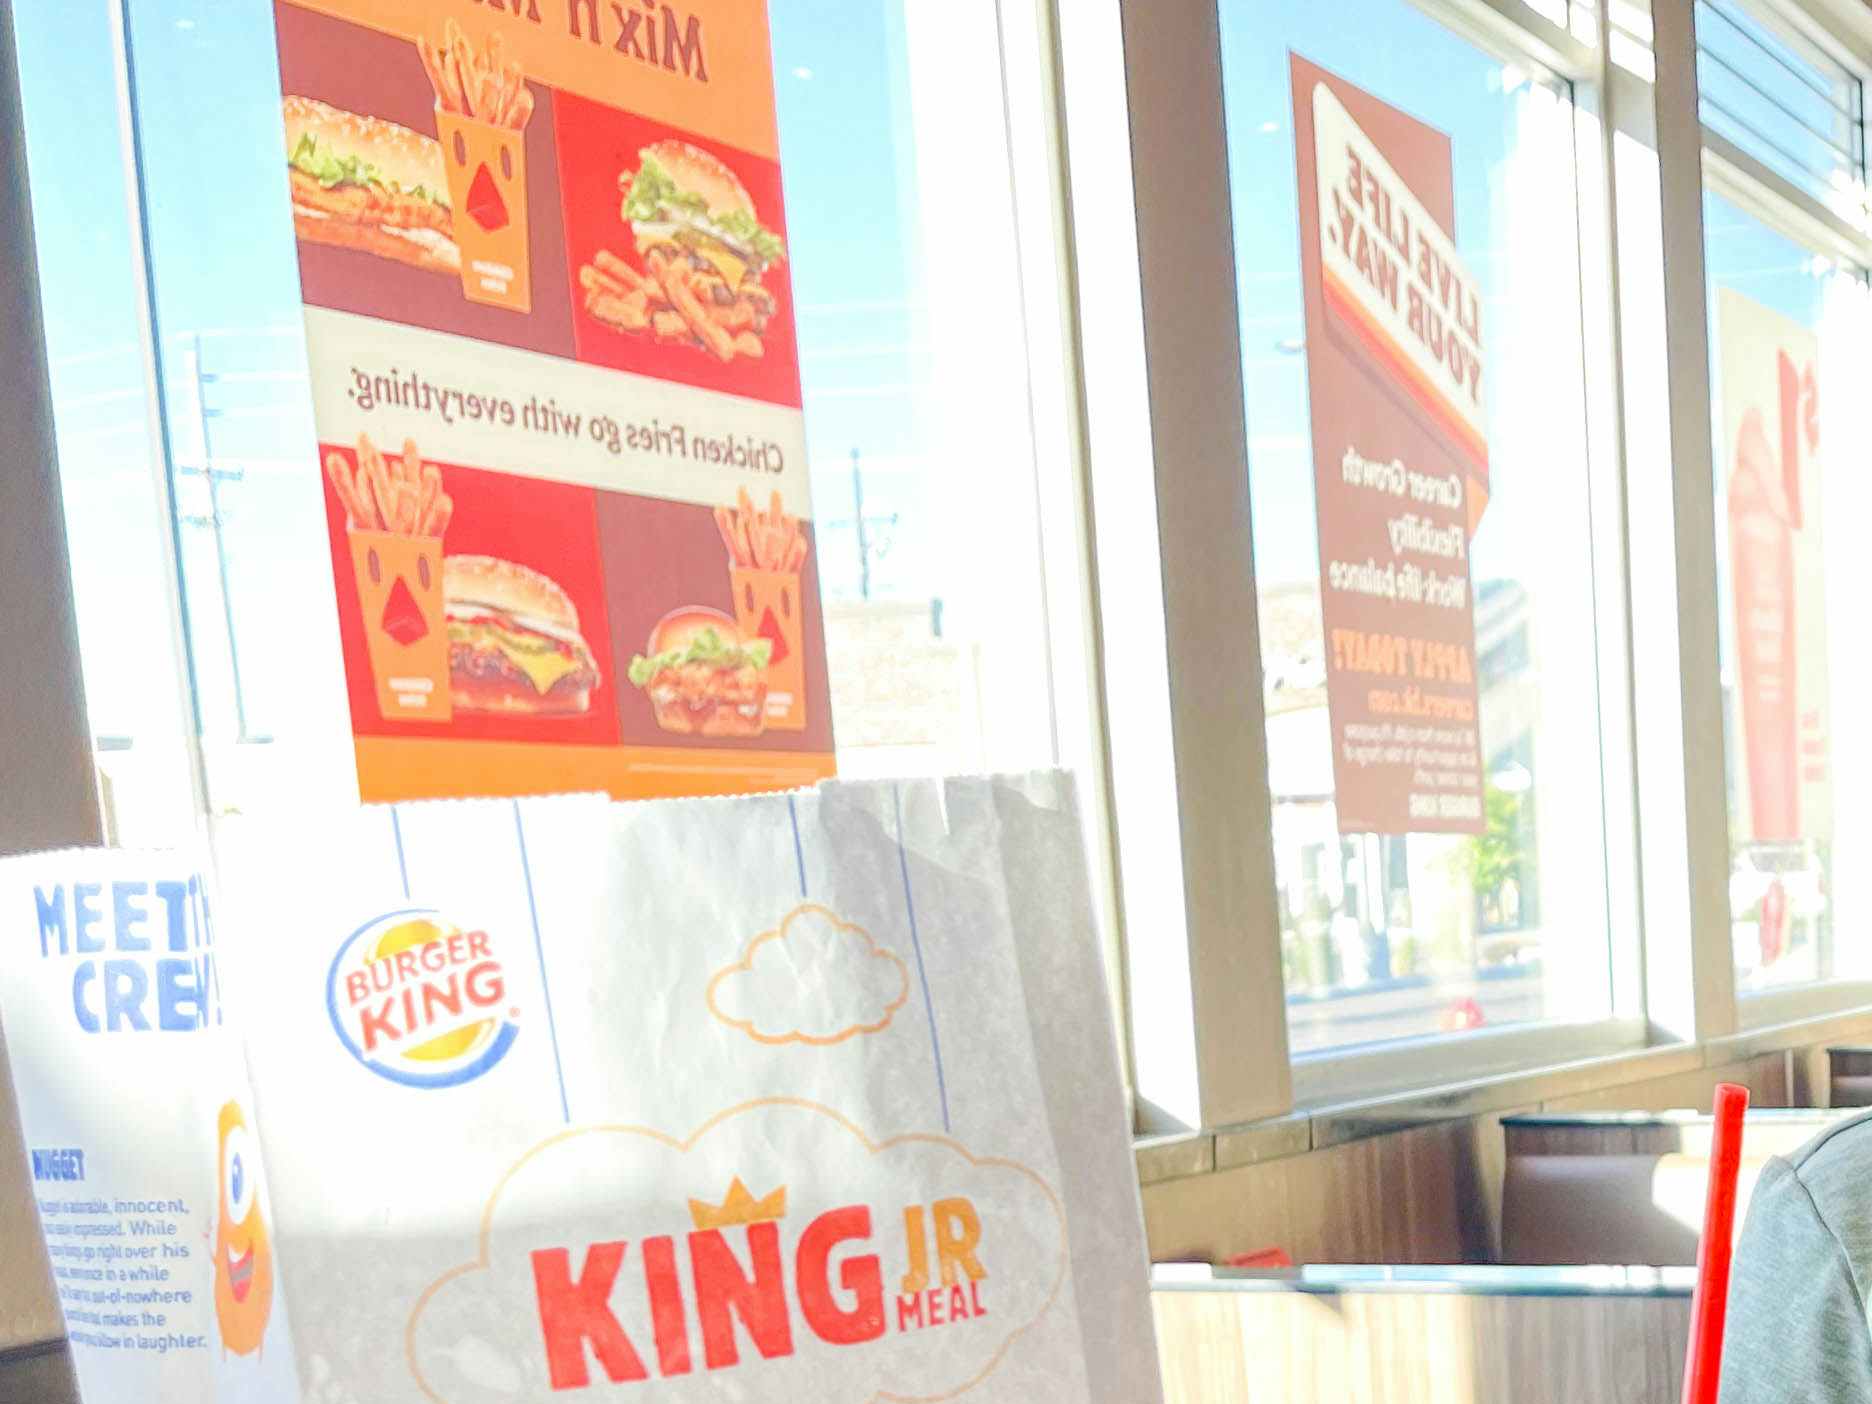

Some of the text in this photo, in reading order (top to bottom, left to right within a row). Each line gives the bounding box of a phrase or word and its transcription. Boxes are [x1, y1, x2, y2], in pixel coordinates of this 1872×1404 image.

[33, 879, 188, 957] MEET
[345, 930, 493, 1005] BURGER
[359, 960, 506, 1051] KING
[115, 1199, 190, 1214] innocent,
[129, 1220, 177, 1236] While
[125, 1246, 158, 1258] over
[162, 1243, 190, 1258] his
[129, 1266, 170, 1281] while
[530, 1196, 989, 1391] KING JR
[896, 1280, 988, 1333] MEAL
[142, 1310, 167, 1326] the
[138, 1331, 208, 1353] laughter.
